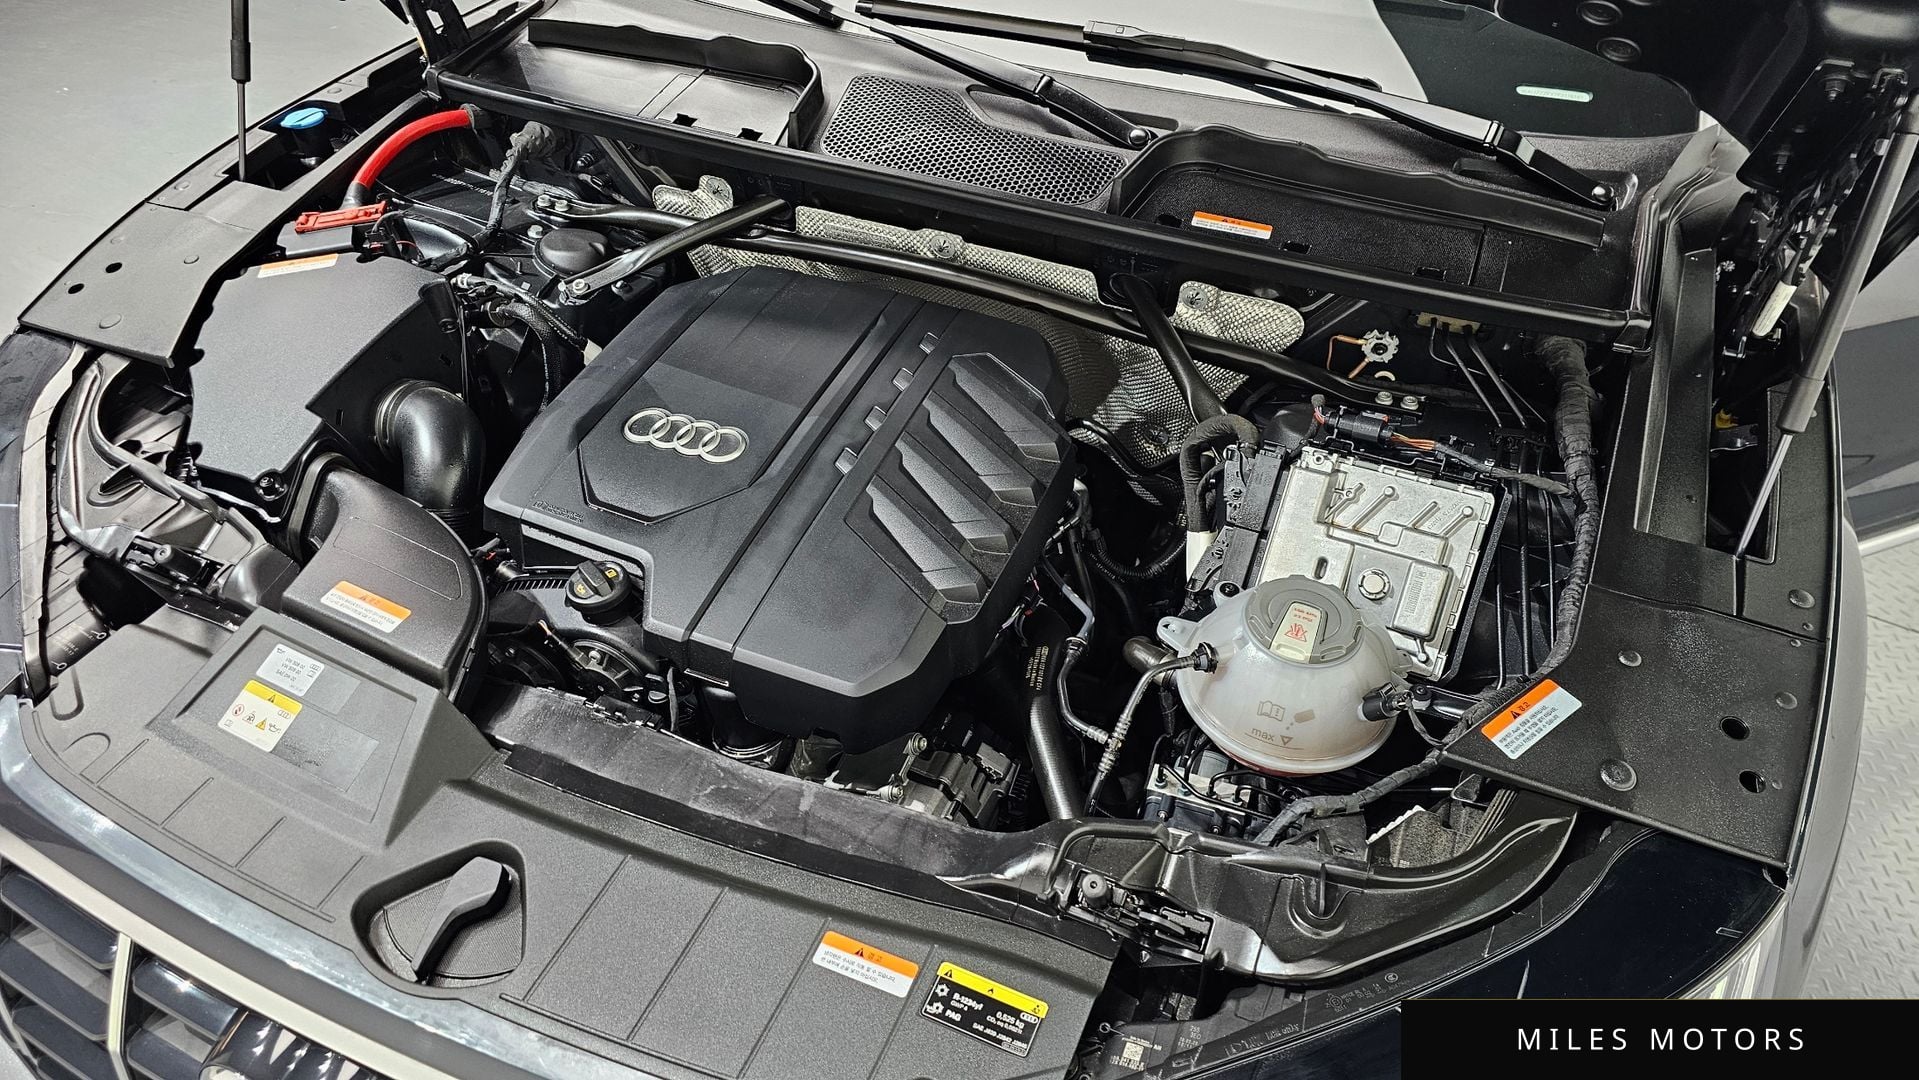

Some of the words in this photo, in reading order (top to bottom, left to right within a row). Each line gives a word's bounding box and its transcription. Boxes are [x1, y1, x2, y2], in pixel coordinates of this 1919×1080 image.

[1518, 702, 1530, 712] 경고
[1251, 728, 1275, 742] max
[945, 1010, 961, 1021] PAG
[1015, 1019, 1025, 1029] kg
